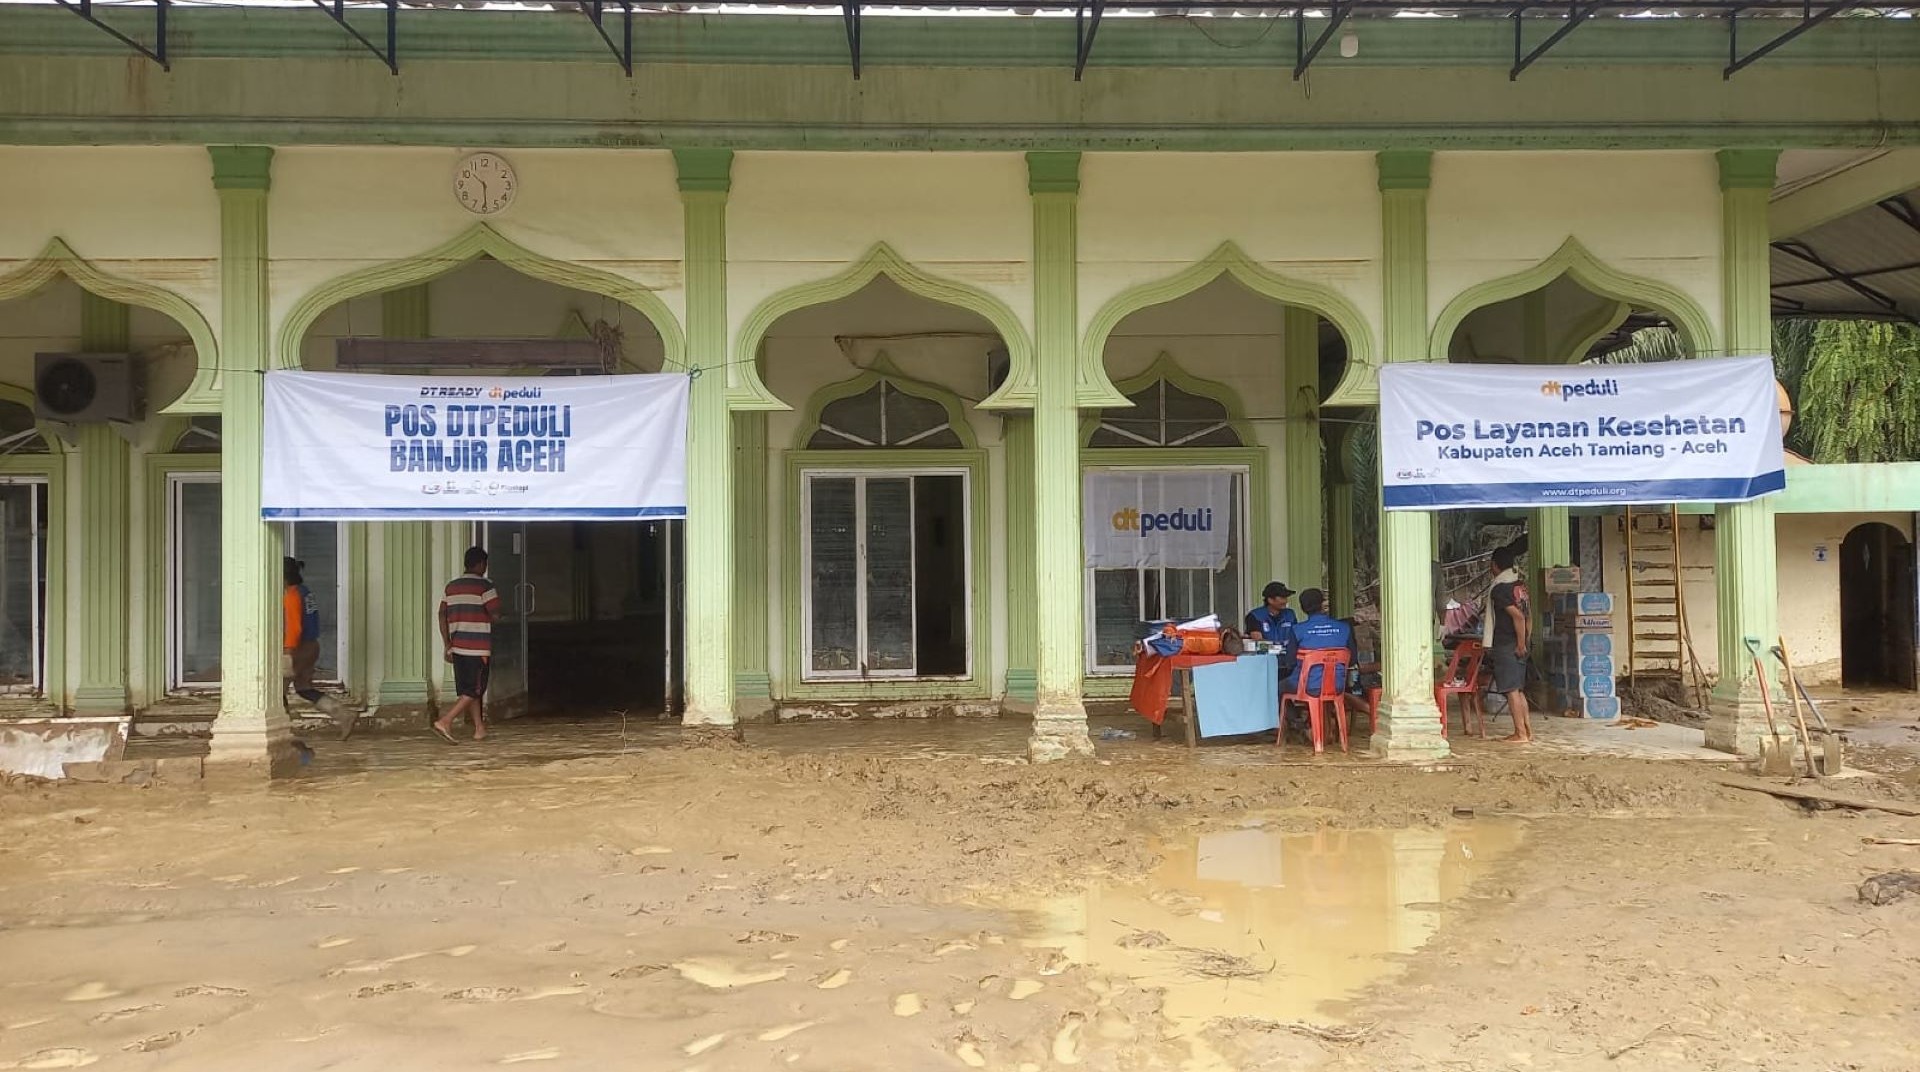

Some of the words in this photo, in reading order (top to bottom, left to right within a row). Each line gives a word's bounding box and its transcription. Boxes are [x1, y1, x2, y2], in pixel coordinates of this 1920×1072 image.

[470, 161, 477, 171] 11
[481, 158, 489, 167] 12
[463, 170, 471, 179] 10
[501, 170, 507, 179] 2
[458, 180, 464, 190] 9
[505, 180, 511, 191] 3
[462, 191, 469, 201] 8
[501, 192, 507, 201] 4
[472, 199, 478, 209] 7
[493, 200, 499, 211] 5
[1541, 378, 1619, 402] dtpeduli
[384, 404, 437, 437] POS
[446, 404, 571, 438] DTPEDULI
[1416, 419, 1466, 441] Pos
[1474, 419, 1590, 444] Layanan
[1598, 414, 1746, 437] Kesehatan
[389, 439, 488, 473] BANJIR
[497, 439, 566, 473] ACEH
[1438, 444, 1533, 462] Kabupaten
[1538, 443, 1583, 457] Aceh
[1587, 441, 1665, 458] Tamiang
[1681, 439, 1728, 454] Aceh
[1542, 486, 1627, 497] www.dtpeduli.org
[1111, 507, 1212, 538] dtpeduli
